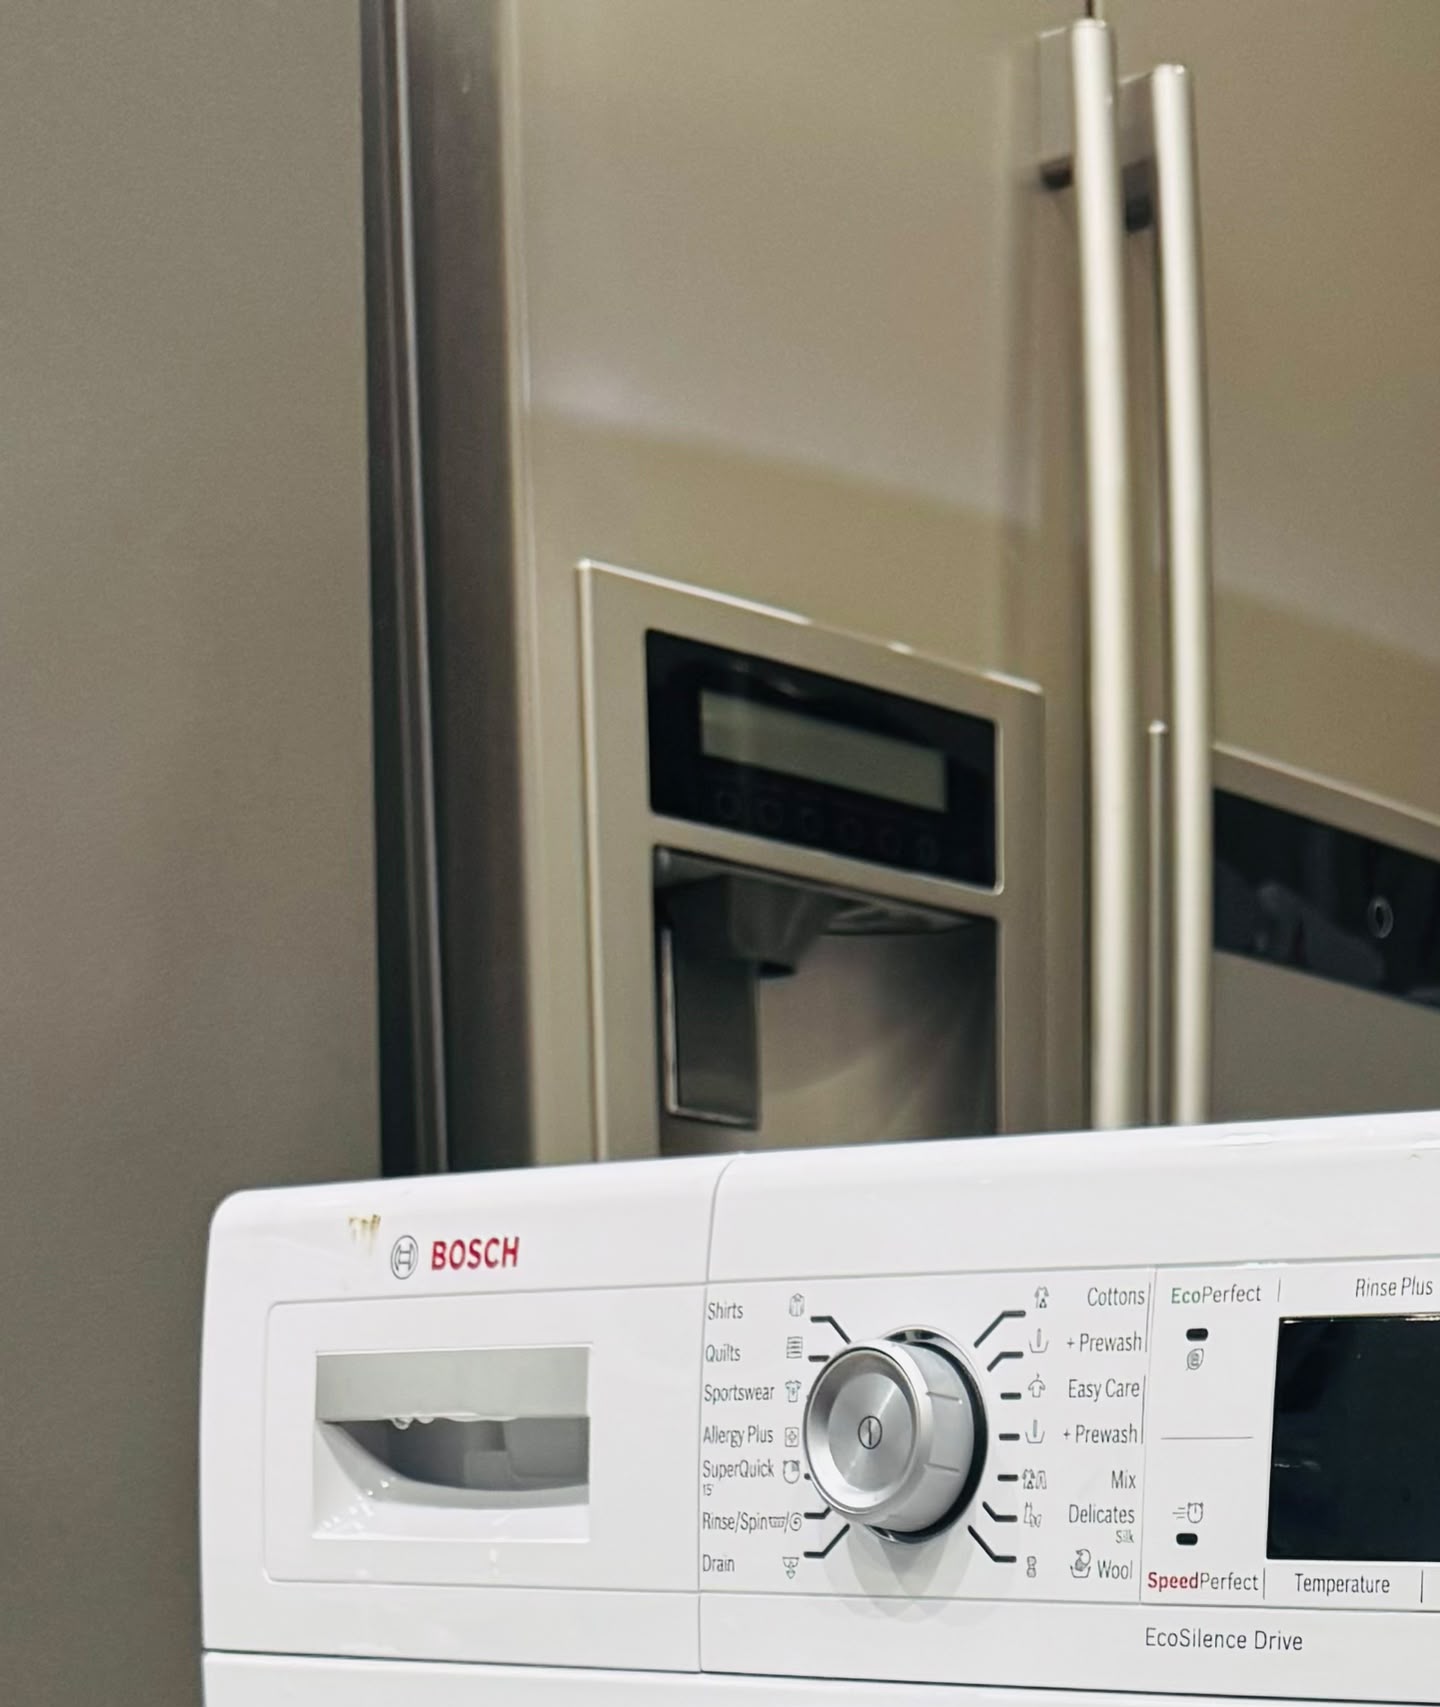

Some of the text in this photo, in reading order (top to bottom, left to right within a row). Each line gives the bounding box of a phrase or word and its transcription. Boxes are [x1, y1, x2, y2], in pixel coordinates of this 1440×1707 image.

[431, 1236, 520, 1271] BOSCH
[1087, 1287, 1145, 1307] Cottons
[1171, 1283, 1261, 1304] EcoPerfect
[1355, 1275, 1433, 1298] Rinse Plus
[706, 1301, 744, 1321] Shirts
[1079, 1331, 1142, 1352] Prewash
[704, 1343, 742, 1364] Quilts
[704, 1383, 775, 1405] Sportswear
[1068, 1378, 1140, 1403] Easy Care
[703, 1424, 774, 1449] Allergy Plus
[1075, 1422, 1138, 1444] Prewash
[702, 1458, 775, 1481] SuperQuick
[1111, 1469, 1136, 1489] Mix
[702, 1511, 768, 1534] Rinse/Spin
[1068, 1503, 1135, 1524] Delicates
[702, 1553, 735, 1572] Drain
[1097, 1559, 1133, 1580] Wool
[1147, 1571, 1258, 1593] SpeedPerfect
[1295, 1572, 1390, 1597] Temperature
[1145, 1627, 1303, 1651] EcoSilence Drive
